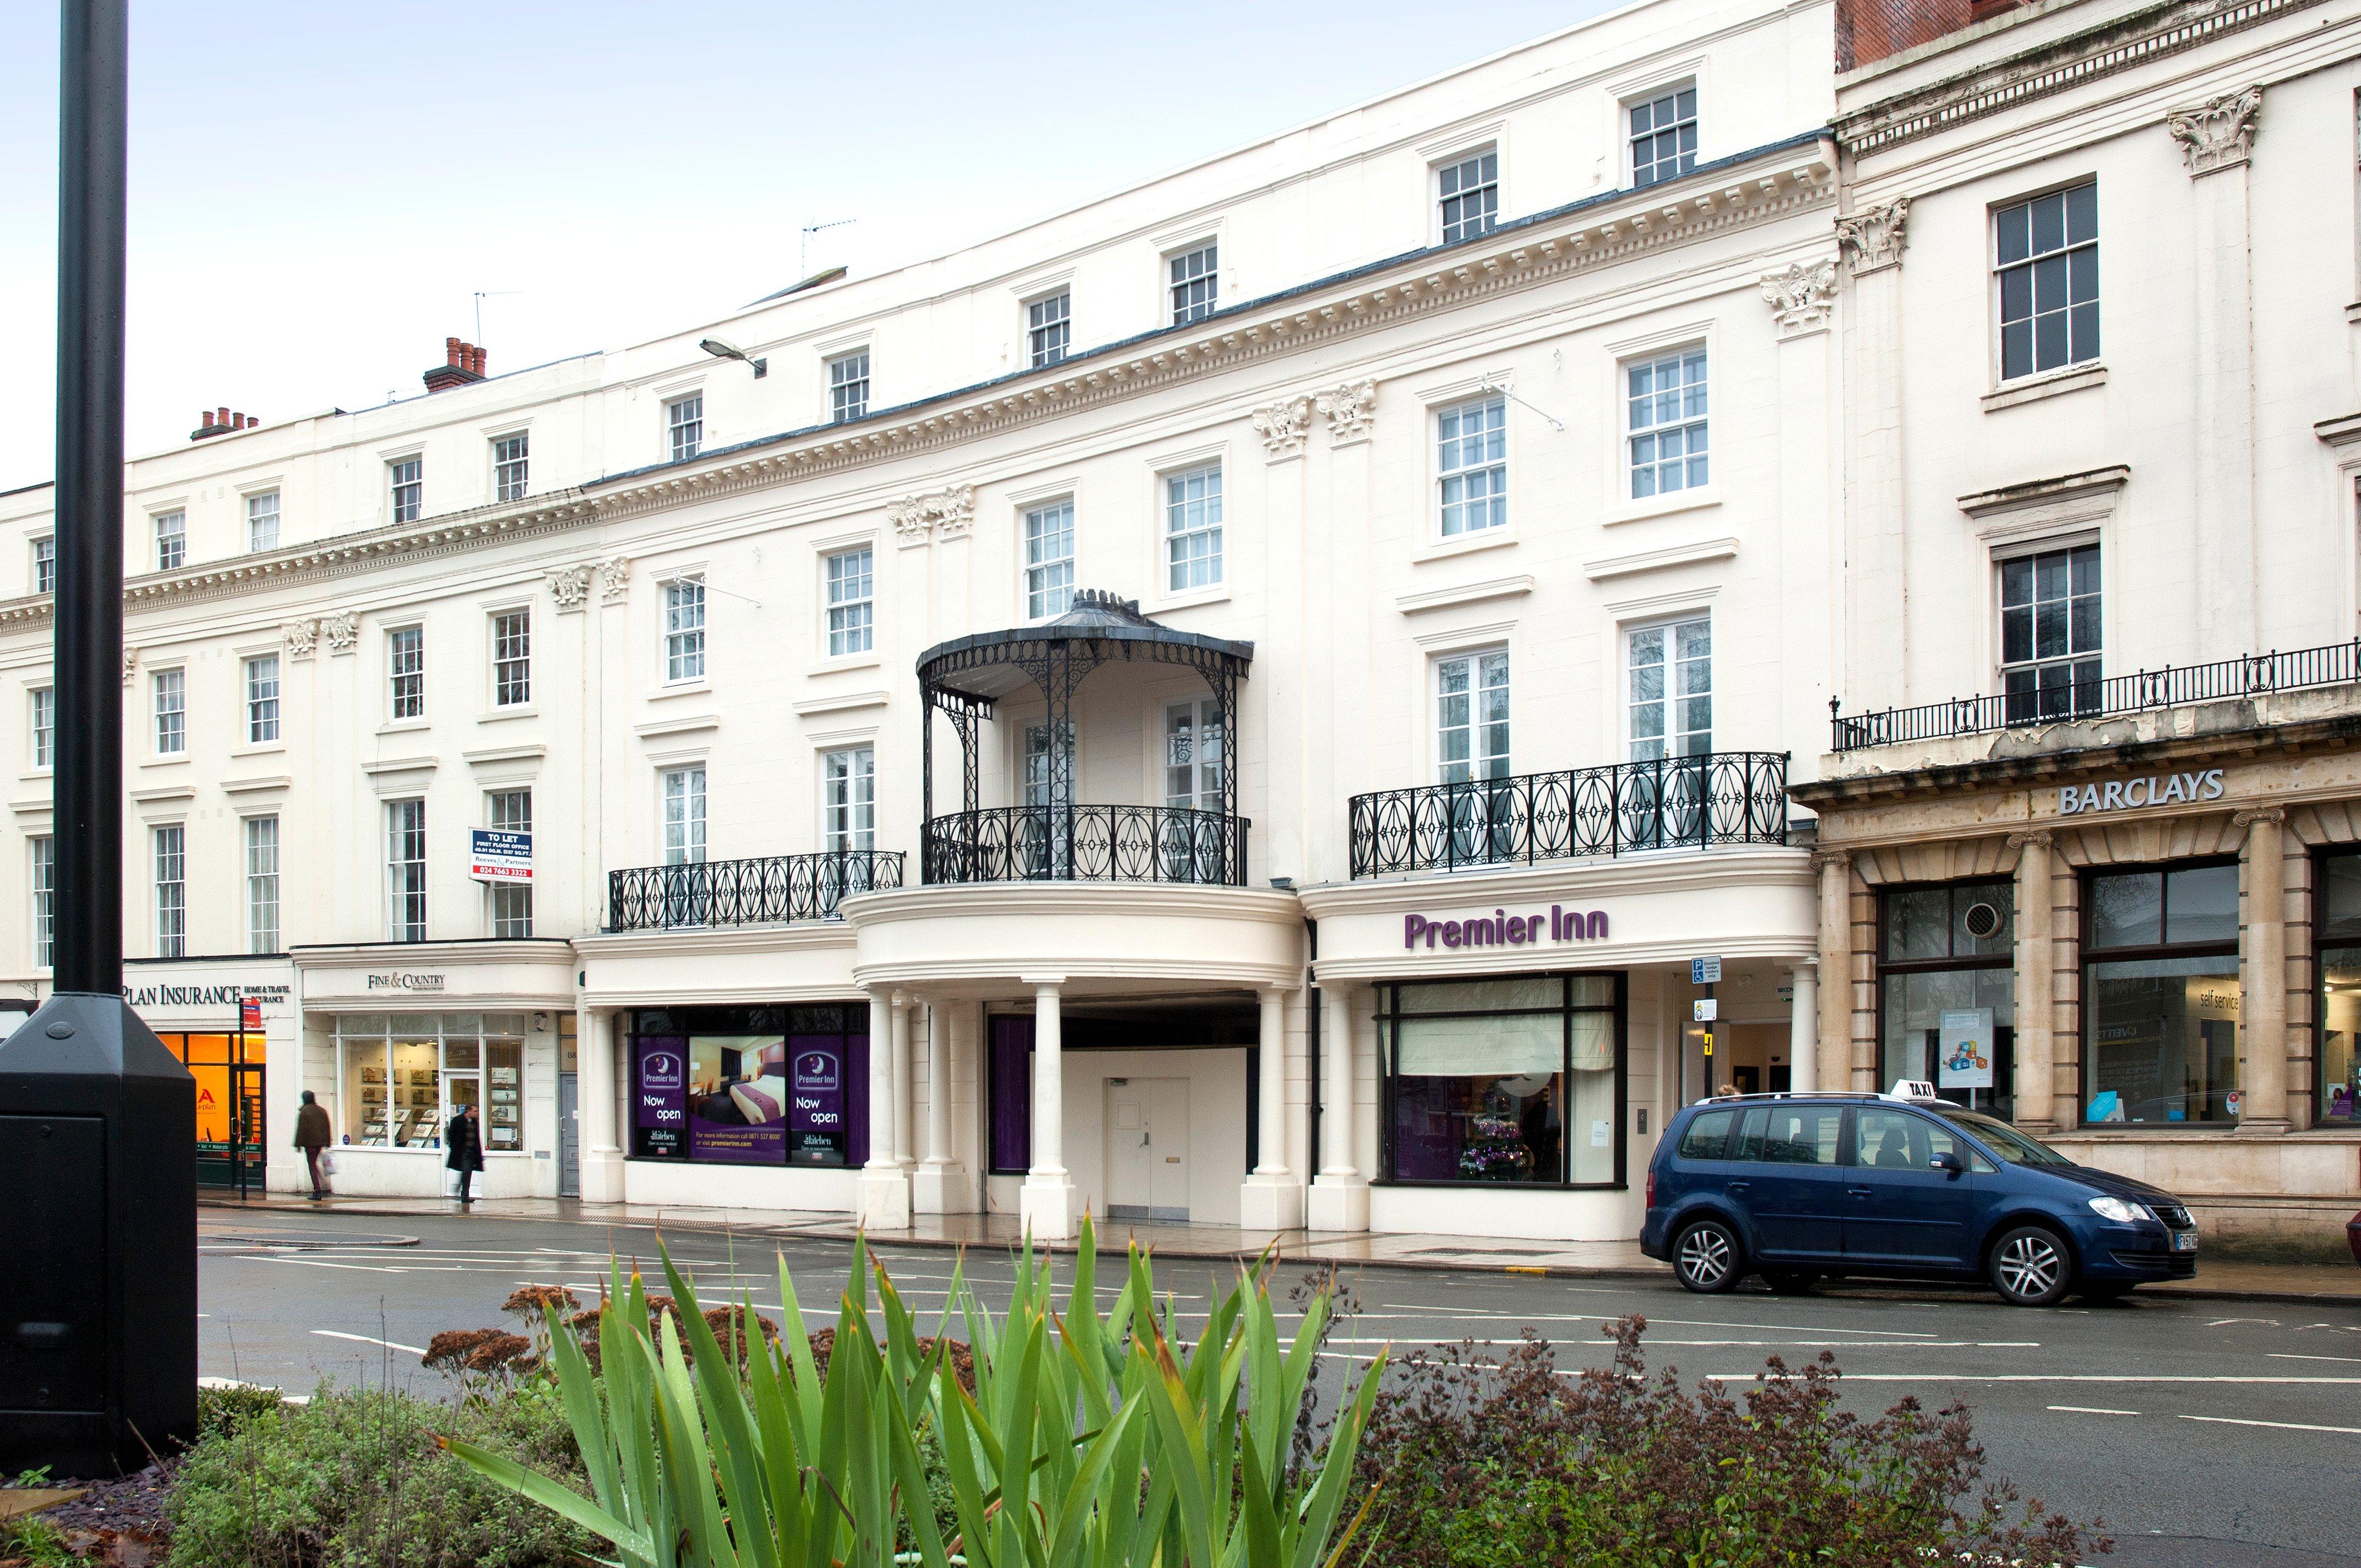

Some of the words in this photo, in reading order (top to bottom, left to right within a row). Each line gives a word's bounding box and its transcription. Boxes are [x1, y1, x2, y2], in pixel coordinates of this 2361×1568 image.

[2060, 769, 2223, 814] BARCLAYS
[497, 857, 504, 866] &
[1405, 908, 1544, 948] Premier
[1552, 905, 1608, 940] Inn
[368, 974, 389, 989] FINE
[391, 972, 401, 987] &
[402, 974, 445, 988] COUNTRY
[160, 984, 241, 1005] INSURANCE
[2201, 989, 2213, 1007] self
[2215, 993, 2238, 1010] service
[1909, 1083, 1932, 1096] TAXI
[644, 1095, 665, 1106] Now
[796, 1097, 819, 1109] Now
[657, 1110, 681, 1121] open
[811, 1113, 837, 1125] open
